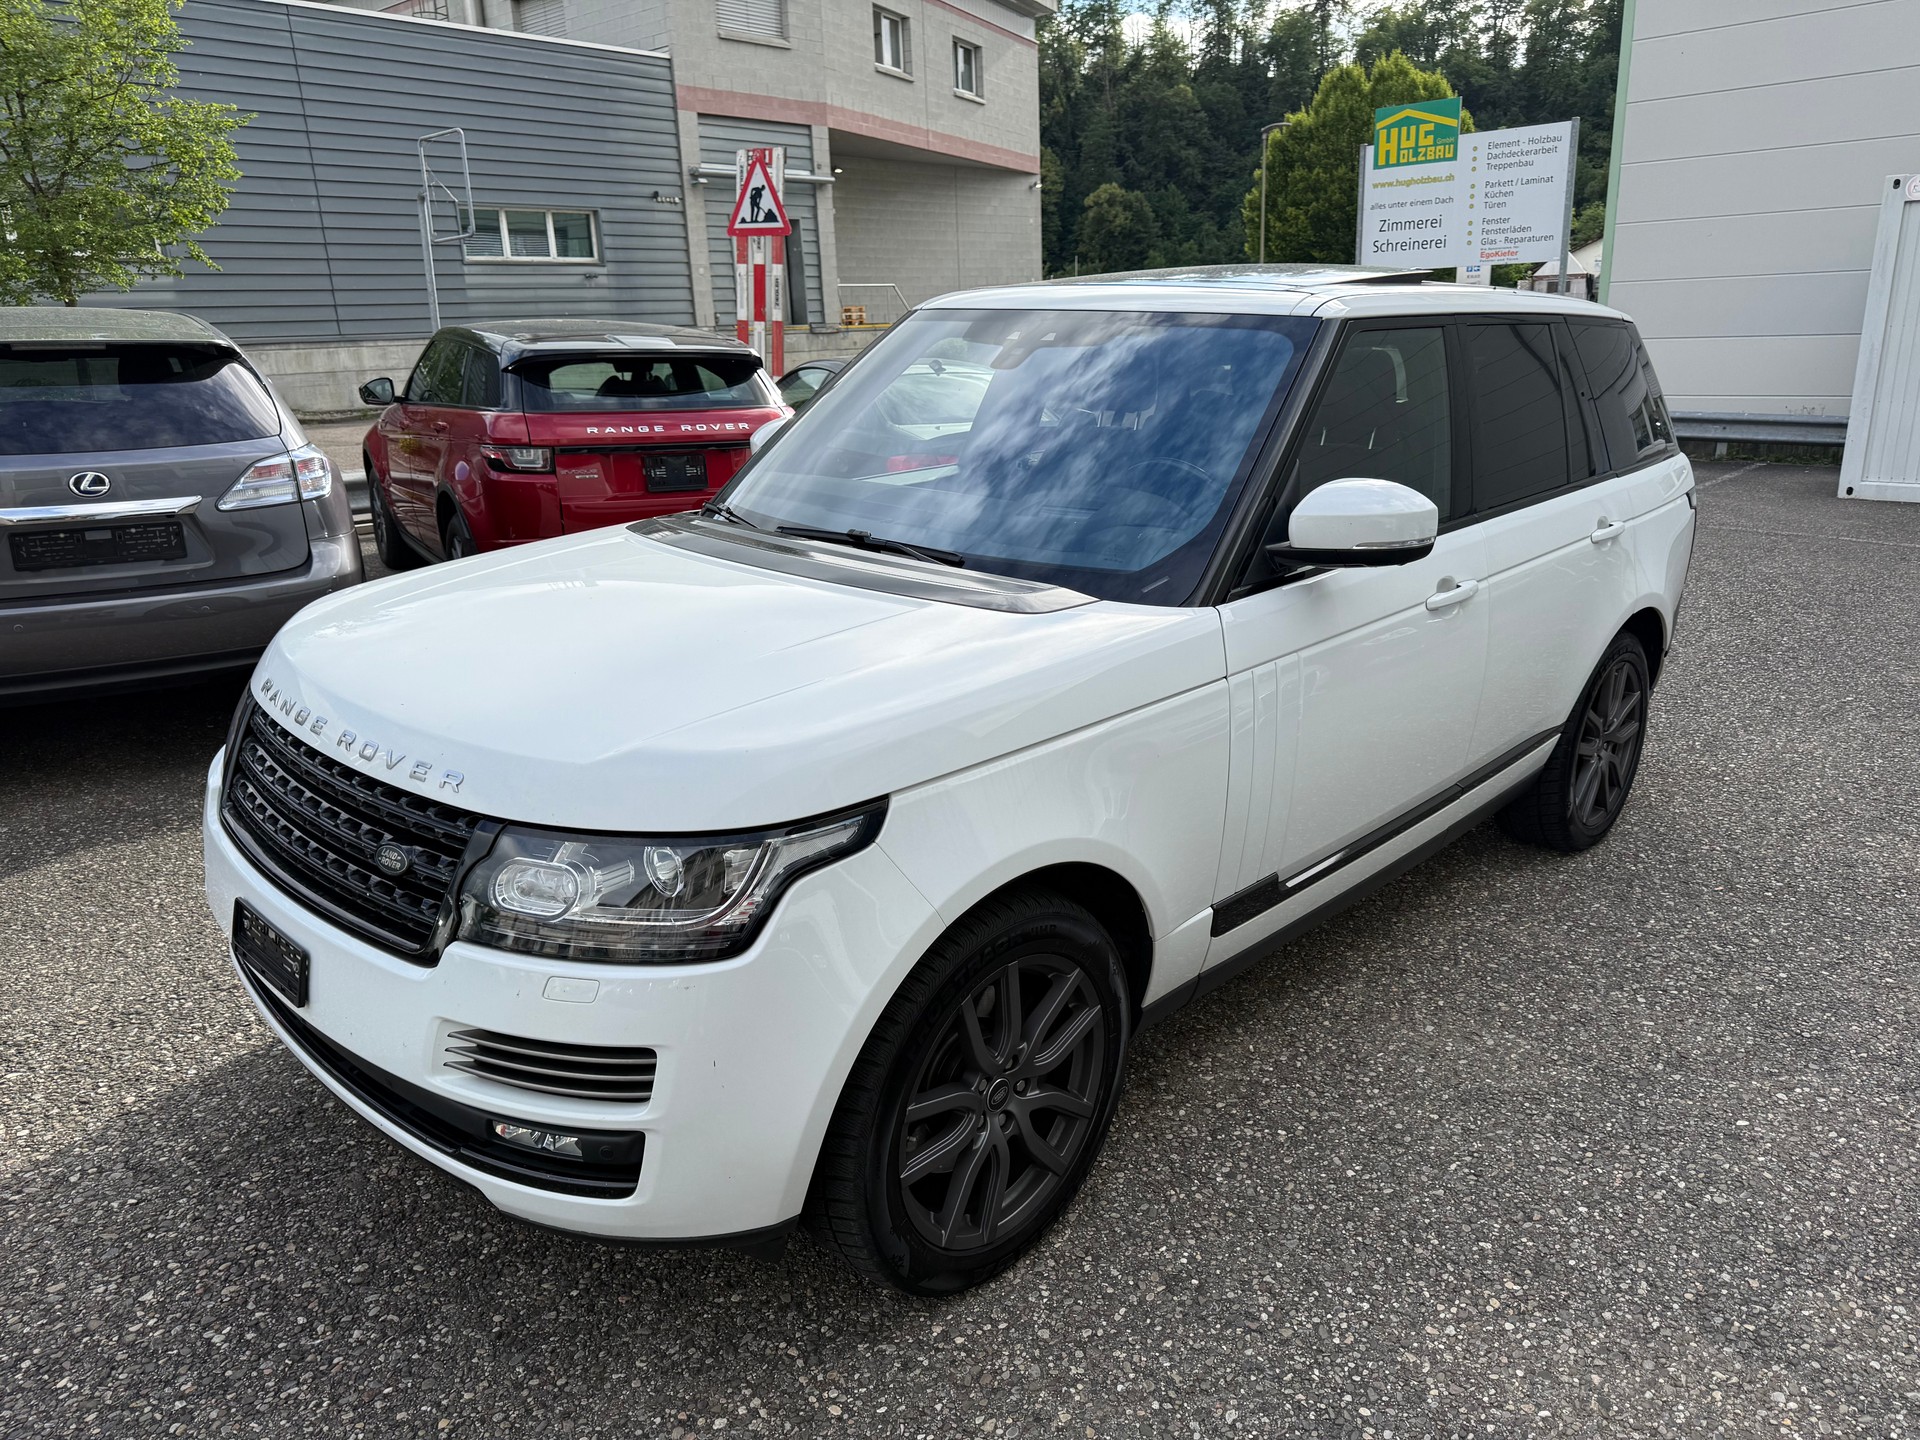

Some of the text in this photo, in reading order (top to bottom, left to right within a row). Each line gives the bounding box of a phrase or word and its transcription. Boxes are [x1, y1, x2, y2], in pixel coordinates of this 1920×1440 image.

[1487, 139, 1520, 150] Element
[1527, 134, 1563, 146] Holzbau
[1486, 145, 1558, 161] Dachdeckerarbeit
[1486, 158, 1534, 171] Treppenbau
[1485, 178, 1514, 189] Parkett
[1520, 175, 1554, 186] Laminat
[1484, 189, 1514, 199] Küchen
[1370, 196, 1454, 211] alles unter einem Dach
[1483, 201, 1507, 209] Türen
[1379, 214, 1443, 233] Zimmerei
[1482, 216, 1511, 225] Fenster
[1481, 225, 1532, 236] Fensterläden
[1372, 234, 1447, 254] Schreinerei
[1480, 236, 1498, 246] Glas
[1503, 233, 1555, 246] Reparaturen
[586, 422, 751, 434] RANGE ROVER
[260, 678, 465, 794] RANGE ROVER
